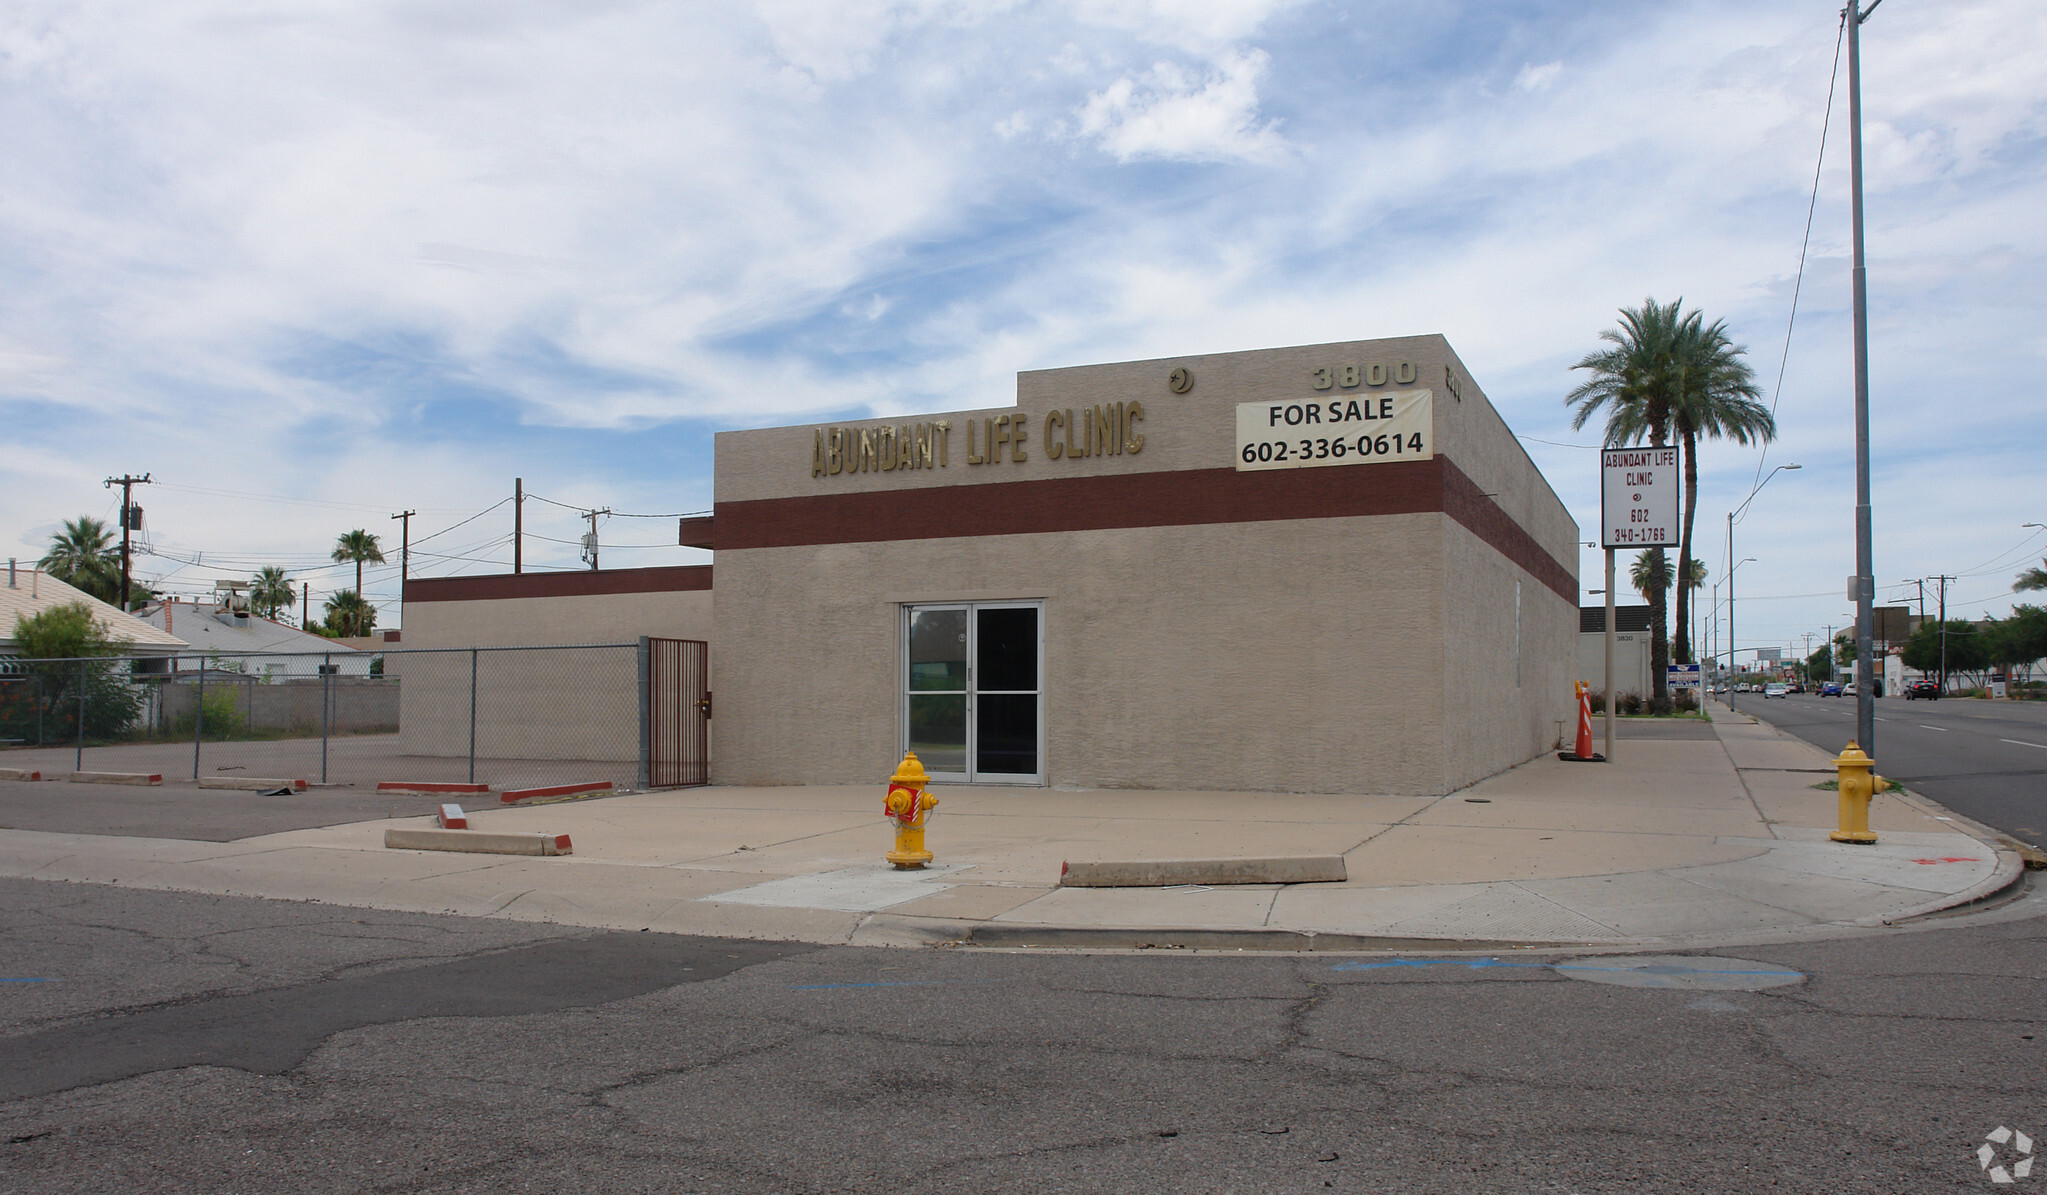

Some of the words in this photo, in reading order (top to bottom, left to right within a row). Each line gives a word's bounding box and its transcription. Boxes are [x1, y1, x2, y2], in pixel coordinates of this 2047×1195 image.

[1313, 360, 1417, 390] 3800
[1269, 403, 1321, 427] FOR
[1328, 398, 1394, 423] SALE
[811, 419, 951, 478] ABUNDANT
[967, 413, 1027, 465] LIFE
[1043, 400, 1144, 460] CLINIC
[1241, 432, 1424, 464] 602-336-0614
[1605, 453, 1652, 468] ABUNDANT
[1655, 452, 1673, 466] LIFE
[1626, 472, 1653, 486] CLINIC
[1630, 509, 1649, 523] 602
[1614, 528, 1665, 542] 340-1766
